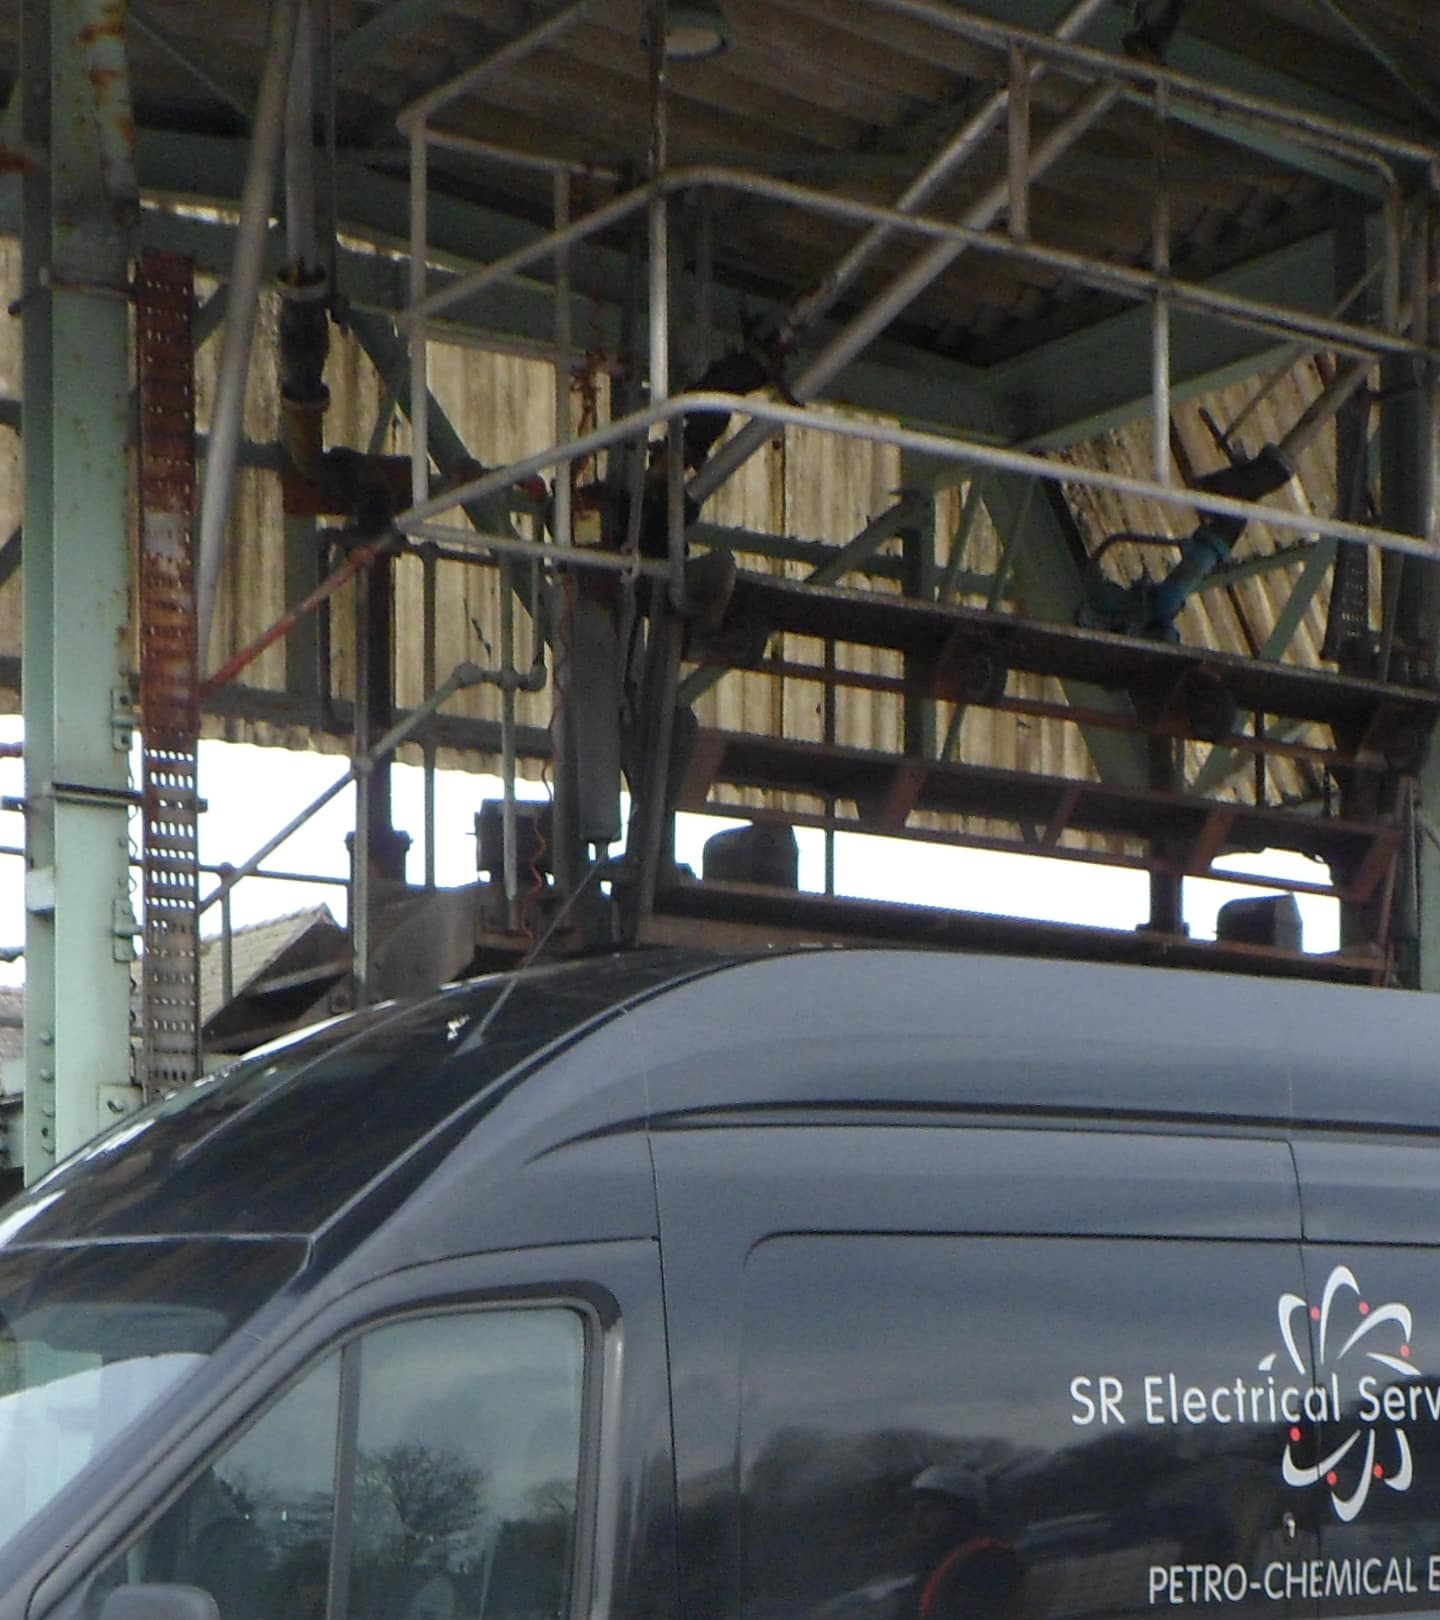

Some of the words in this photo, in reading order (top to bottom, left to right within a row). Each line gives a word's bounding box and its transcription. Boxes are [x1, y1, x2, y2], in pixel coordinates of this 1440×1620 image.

[1070, 1376, 1125, 1425] SR
[1144, 1372, 1341, 1425] Electrical
[1149, 1557, 1417, 1604] PETRO-CHEMICAL
